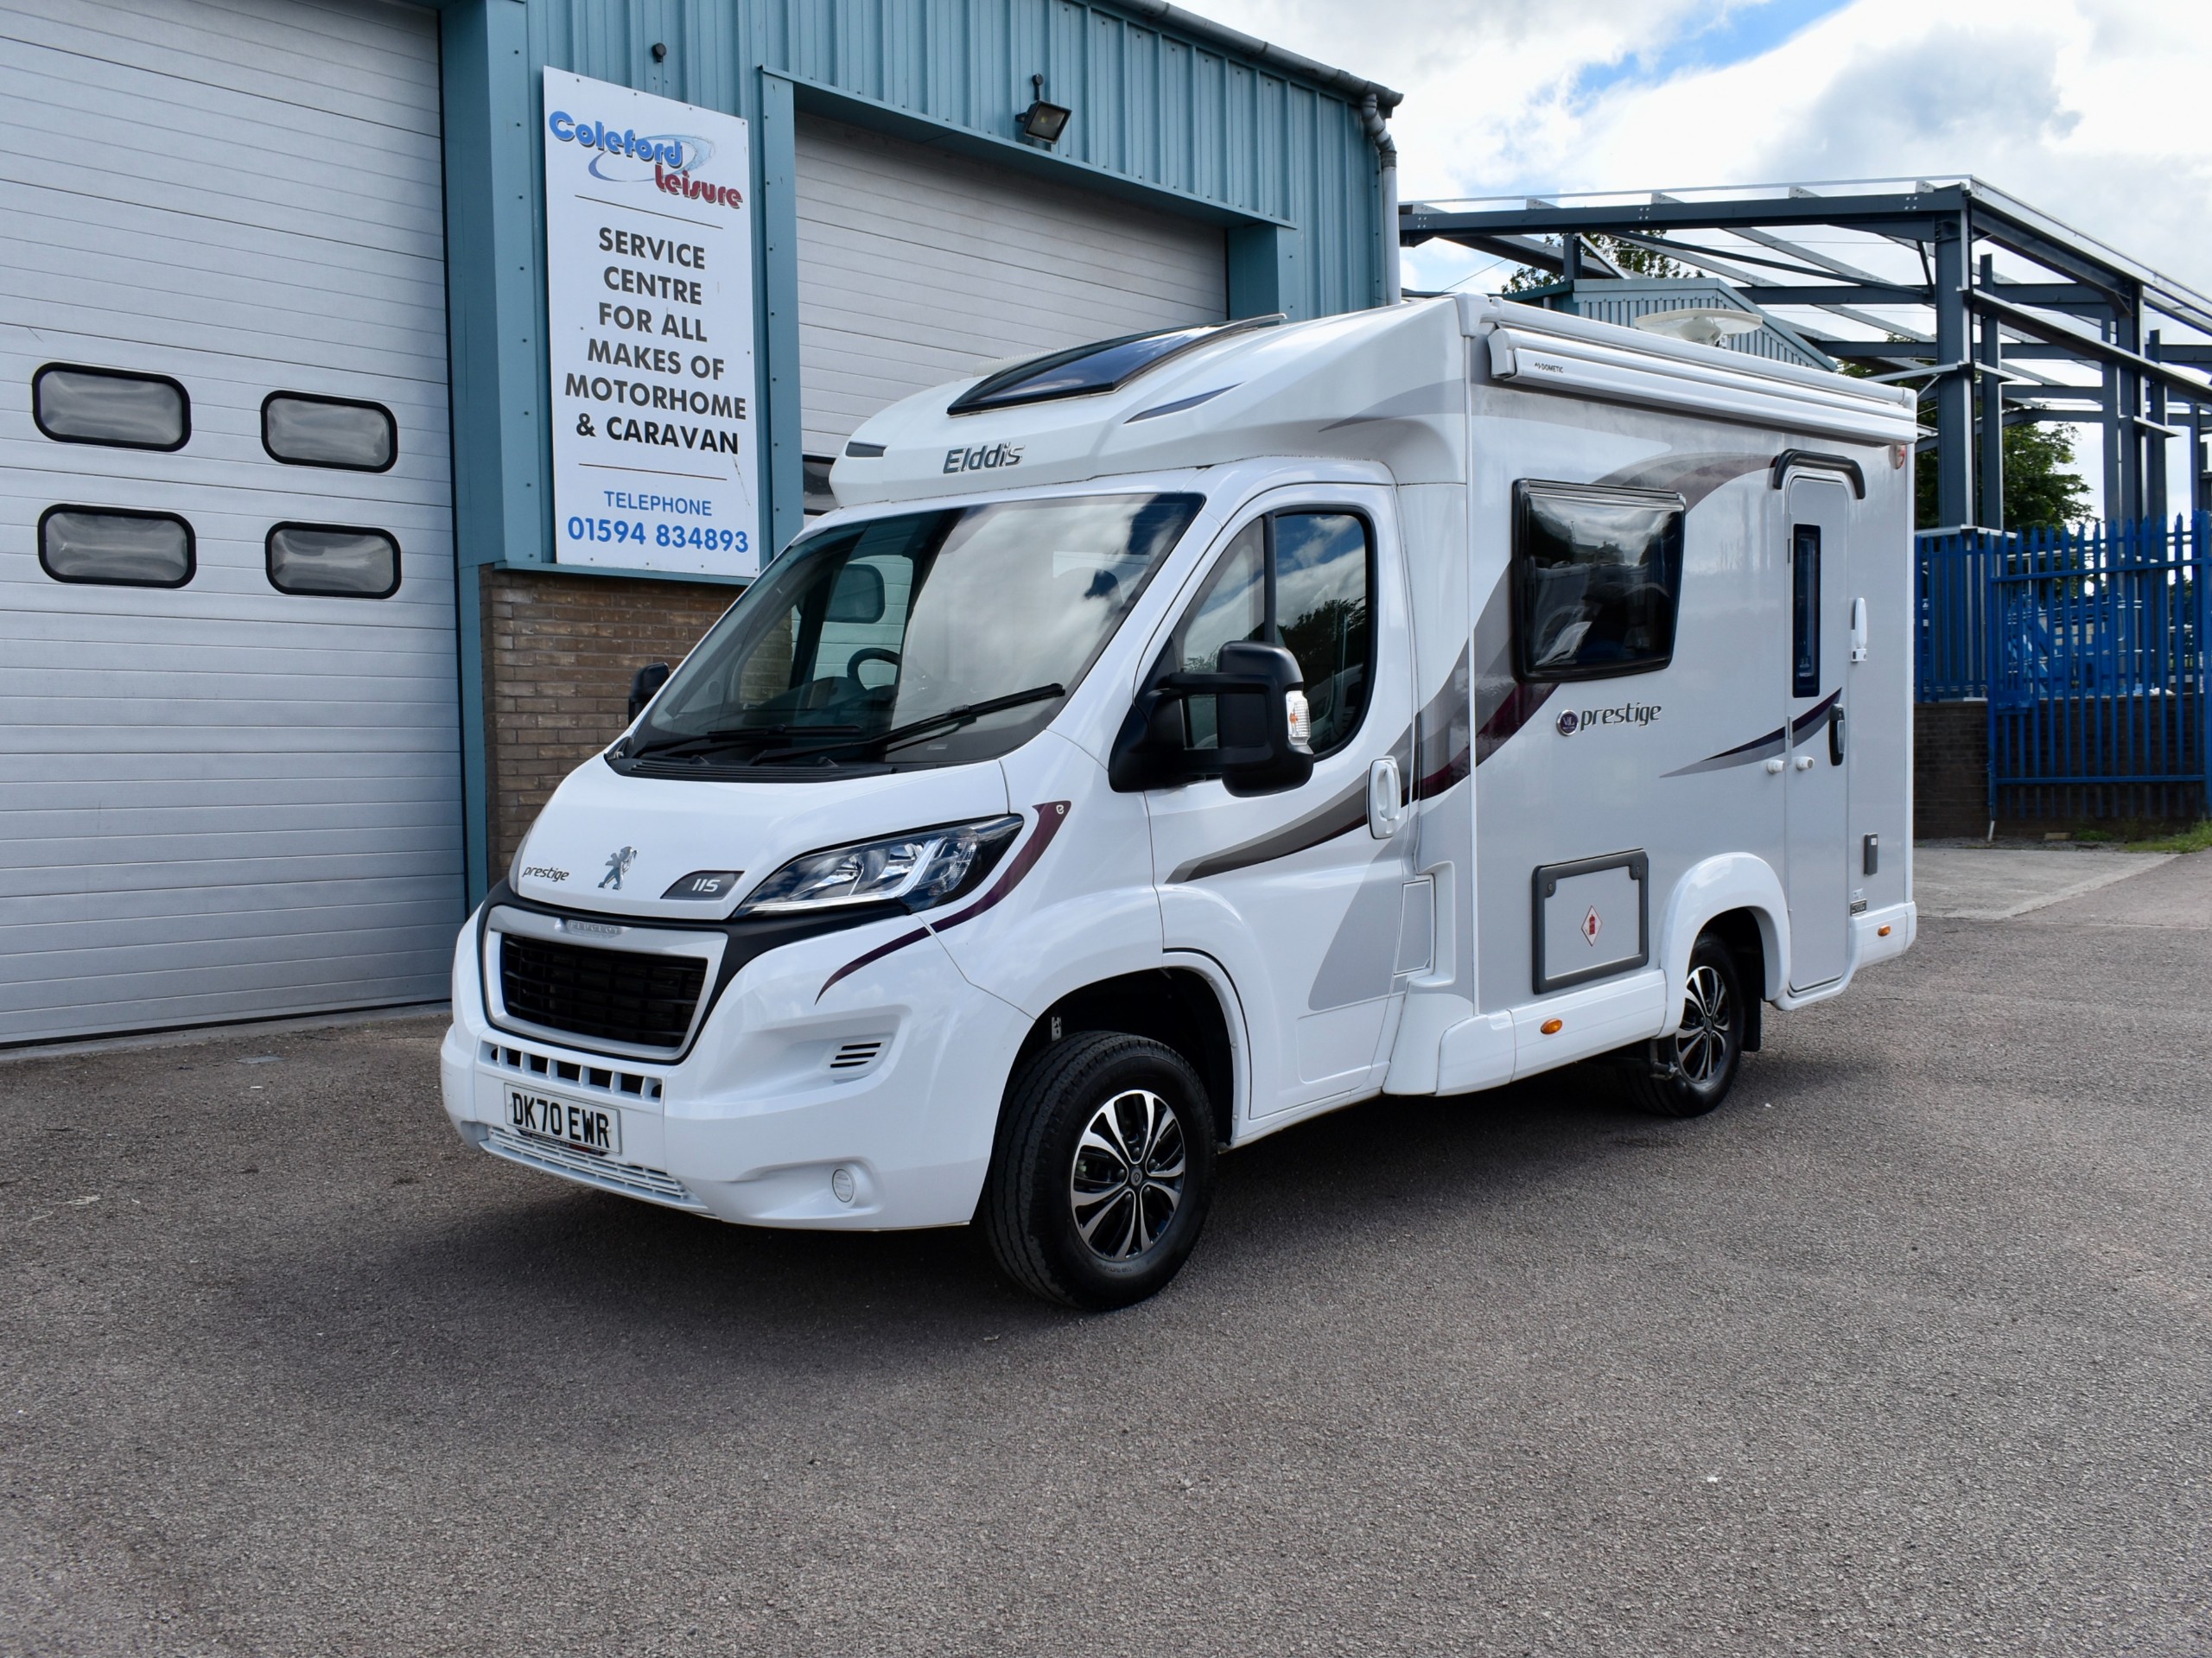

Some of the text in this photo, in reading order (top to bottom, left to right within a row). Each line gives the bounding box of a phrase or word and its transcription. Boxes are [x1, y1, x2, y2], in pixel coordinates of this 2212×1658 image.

[549, 111, 683, 168] Coleford
[599, 227, 705, 270] SERVICE
[604, 266, 702, 305] CENTRE
[599, 302, 708, 342] FOR ALL
[588, 338, 724, 380] MAKES OF
[1541, 363, 1564, 373] DOMETIC
[565, 372, 747, 420] MOTORHOME
[576, 412, 739, 454] & CARAVAN
[943, 441, 1026, 473] Elddis
[604, 491, 712, 517] TELEPHONE
[568, 516, 749, 553] 01594 834893
[1580, 702, 1662, 732] prestige
[522, 865, 569, 882] prestige
[512, 1091, 610, 1148] DK70 EWR
